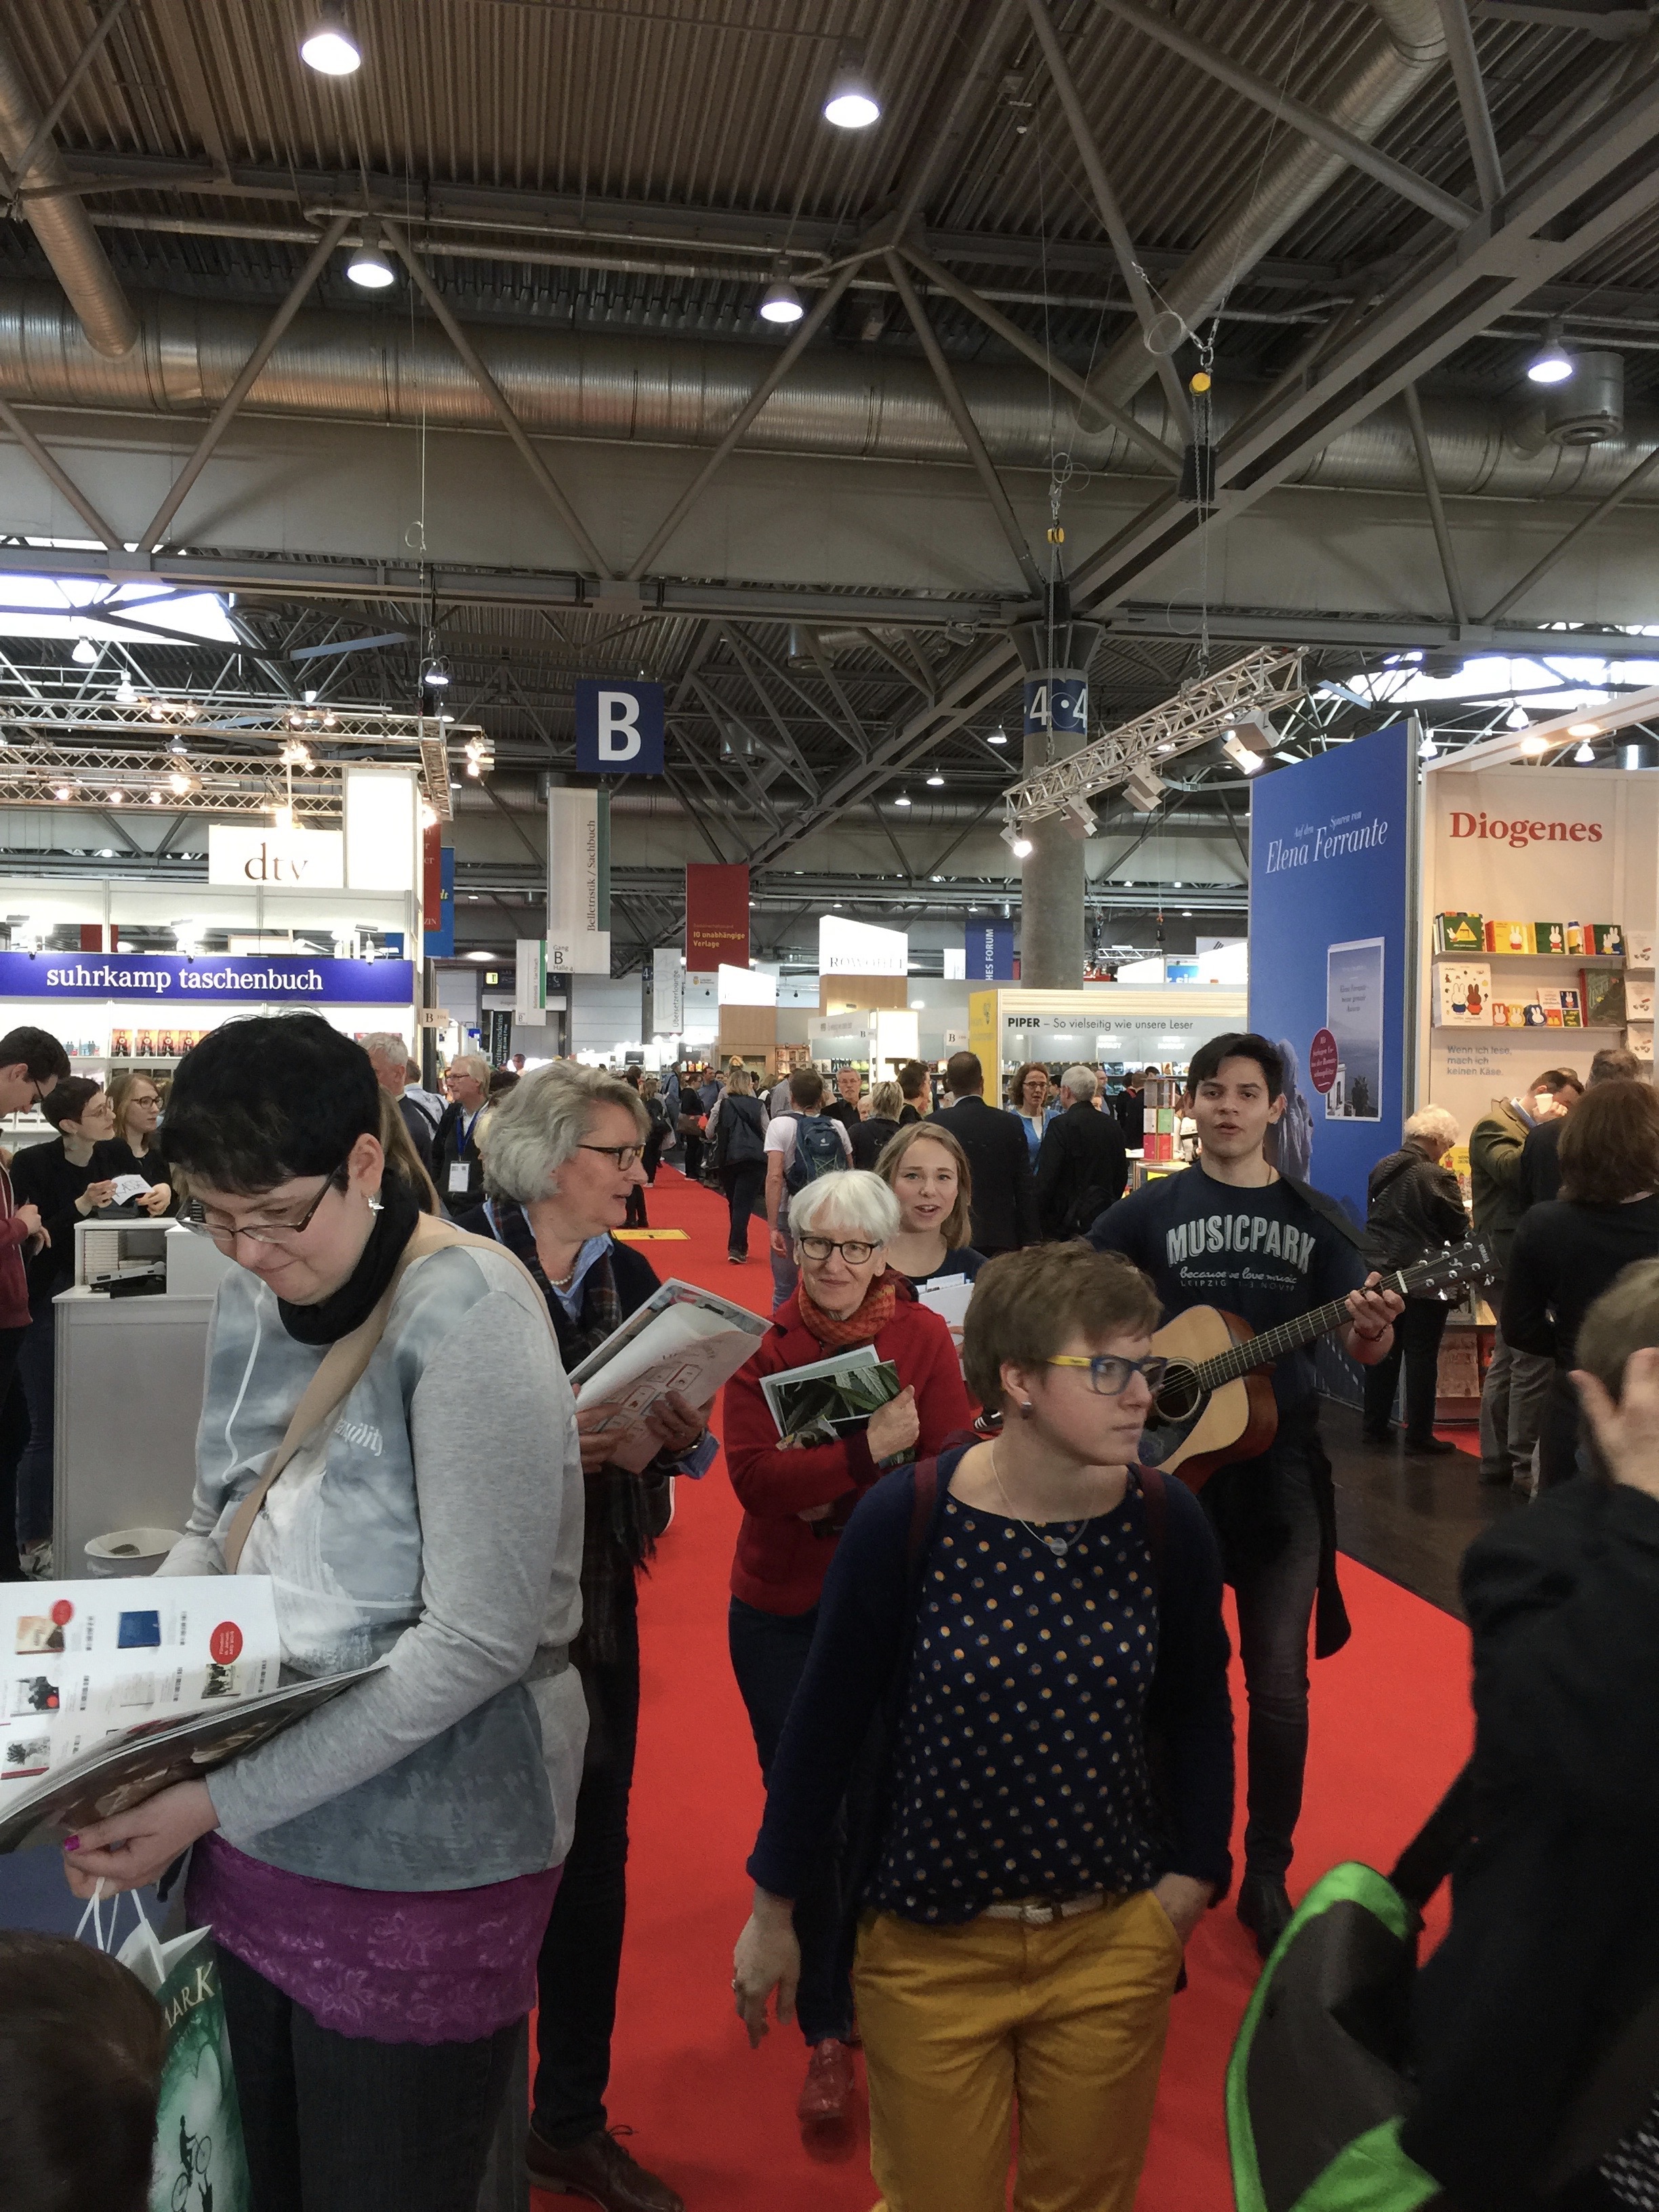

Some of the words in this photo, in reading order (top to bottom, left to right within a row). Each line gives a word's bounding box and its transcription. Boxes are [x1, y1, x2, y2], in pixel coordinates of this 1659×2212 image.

[598, 691, 642, 761] B
[587, 820, 596, 869] Sachbuch
[1449, 812, 1603, 848] Diogenes
[245, 842, 309, 881] dtv
[1265, 839, 1309, 874] Elena
[1313, 818, 1389, 862] Ferrante
[587, 878, 596, 932] Belletristik
[702, 931, 745, 940] unabhängige
[985, 928, 994, 962] FORUM
[554, 951, 564, 964] B
[47, 965, 171, 993] suhrkamp
[179, 967, 324, 991] taschenbuch
[426, 1013, 434, 1022] B
[1008, 1018, 1040, 1027] PIPER
[1053, 1018, 1067, 1028] So
[1069, 1018, 1111, 1031] vielseitig
[1114, 1019, 1132, 1029] wie
[1135, 1021, 1167, 1029] unsere
[1170, 1019, 1194, 1029] Leser
[949, 1033, 956, 1042] B
[1447, 1046, 1473, 1054] Wenn
[1166, 1214, 1316, 1275] MUSICPARK
[1242, 1267, 1265, 1281] love
